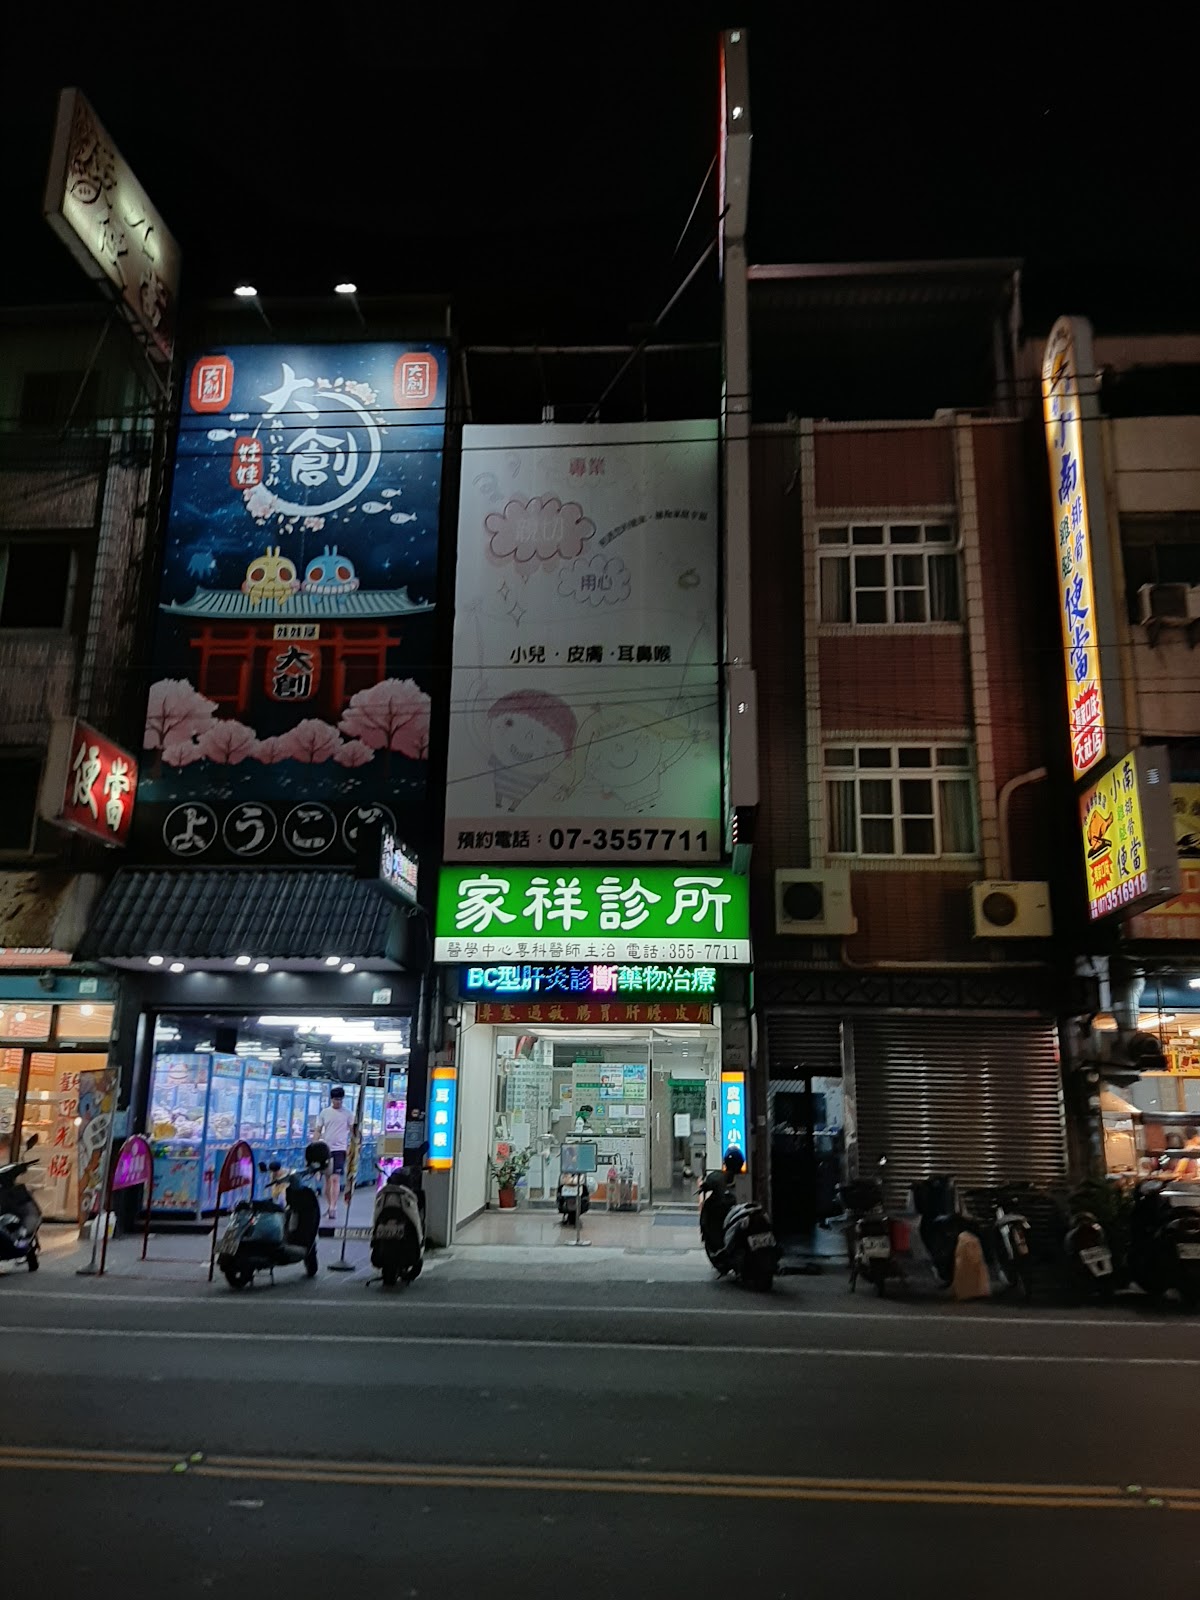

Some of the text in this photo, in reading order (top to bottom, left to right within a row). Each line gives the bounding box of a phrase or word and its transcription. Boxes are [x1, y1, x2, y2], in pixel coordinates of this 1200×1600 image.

[259, 362, 359, 487] 大創
[236, 440, 262, 486] 娃娃
[580, 573, 613, 592] 用心
[1064, 571, 1089, 683] 便當
[273, 645, 315, 699] 大創
[72, 740, 130, 831] 便當
[548, 828, 709, 852] 07-3557711
[455, 873, 732, 933] 家祥診所
[467, 965, 717, 992] BC型肝炎診斷藥物治療
